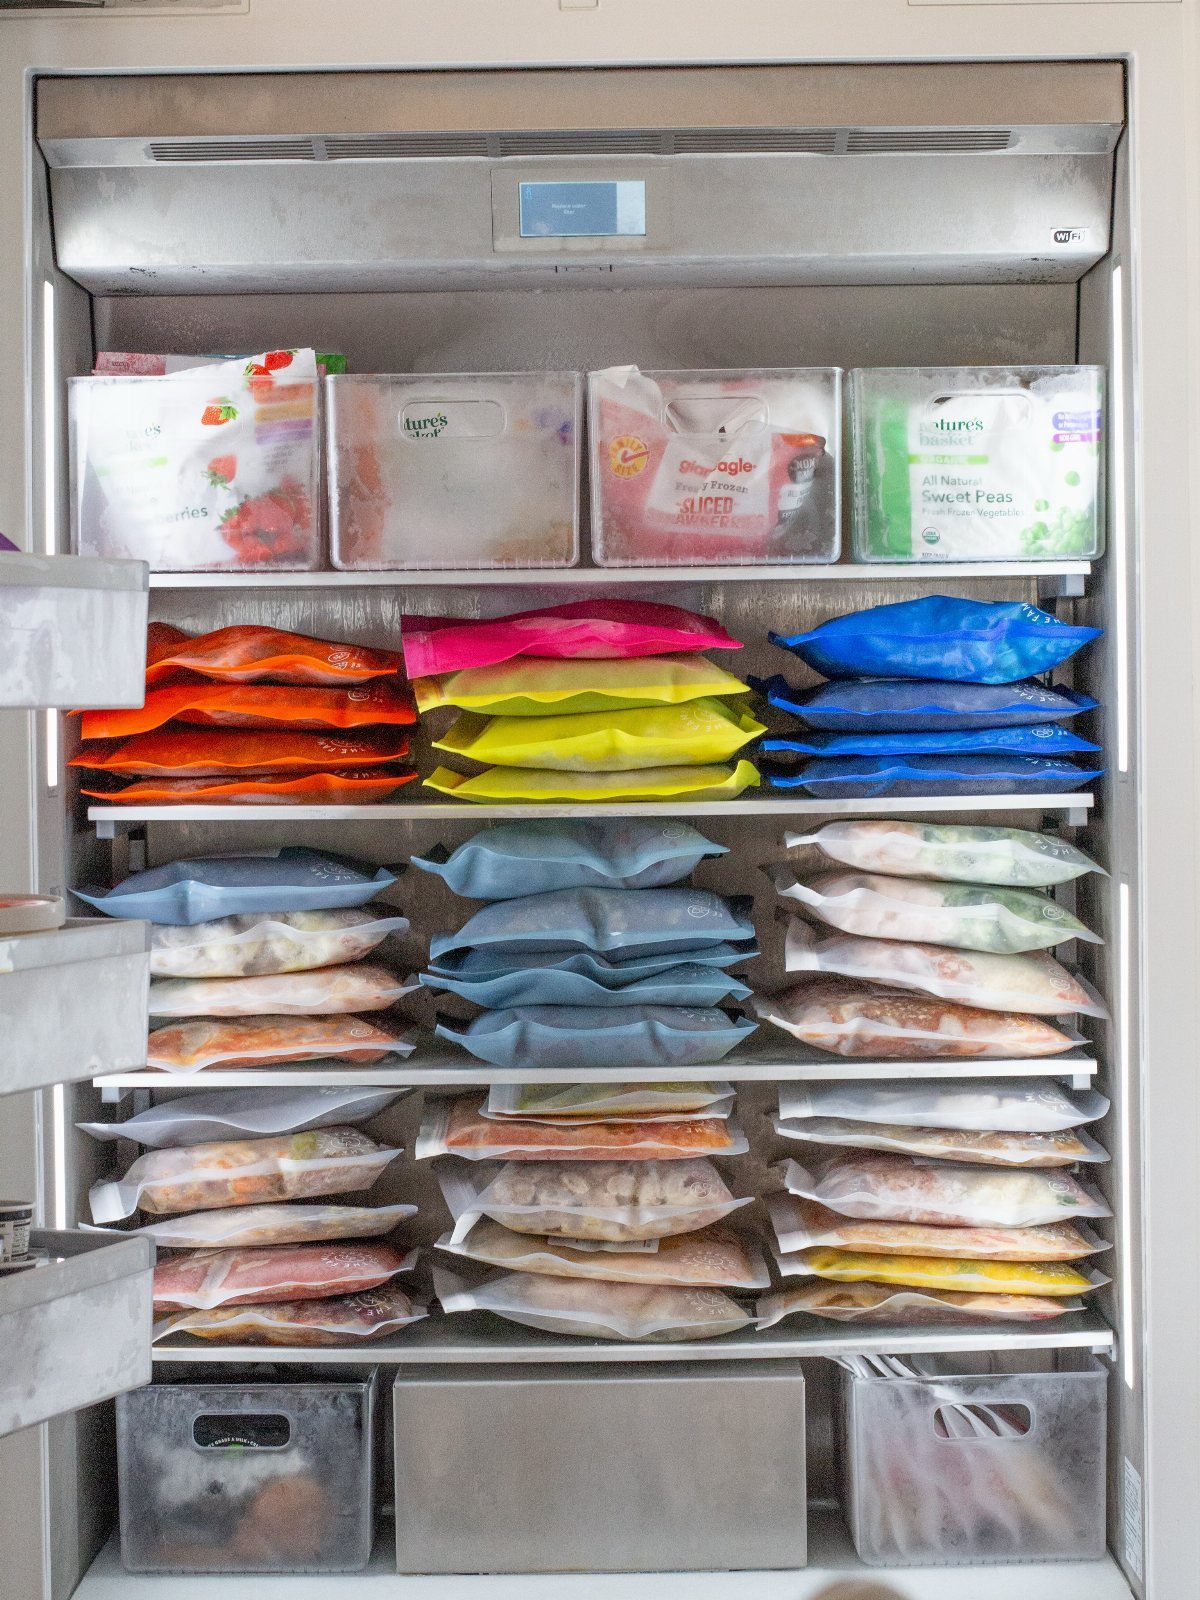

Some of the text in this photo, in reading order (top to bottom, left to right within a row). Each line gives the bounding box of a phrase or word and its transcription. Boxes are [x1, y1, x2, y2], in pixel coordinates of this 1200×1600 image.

[1055, 232, 1082, 241] WiFi
[404, 413, 448, 431] ture's
[679, 458, 753, 477] gian agle
[922, 475, 982, 487] All Natural
[922, 490, 1013, 503] Sweet Peas
[680, 497, 733, 514] SLICED
